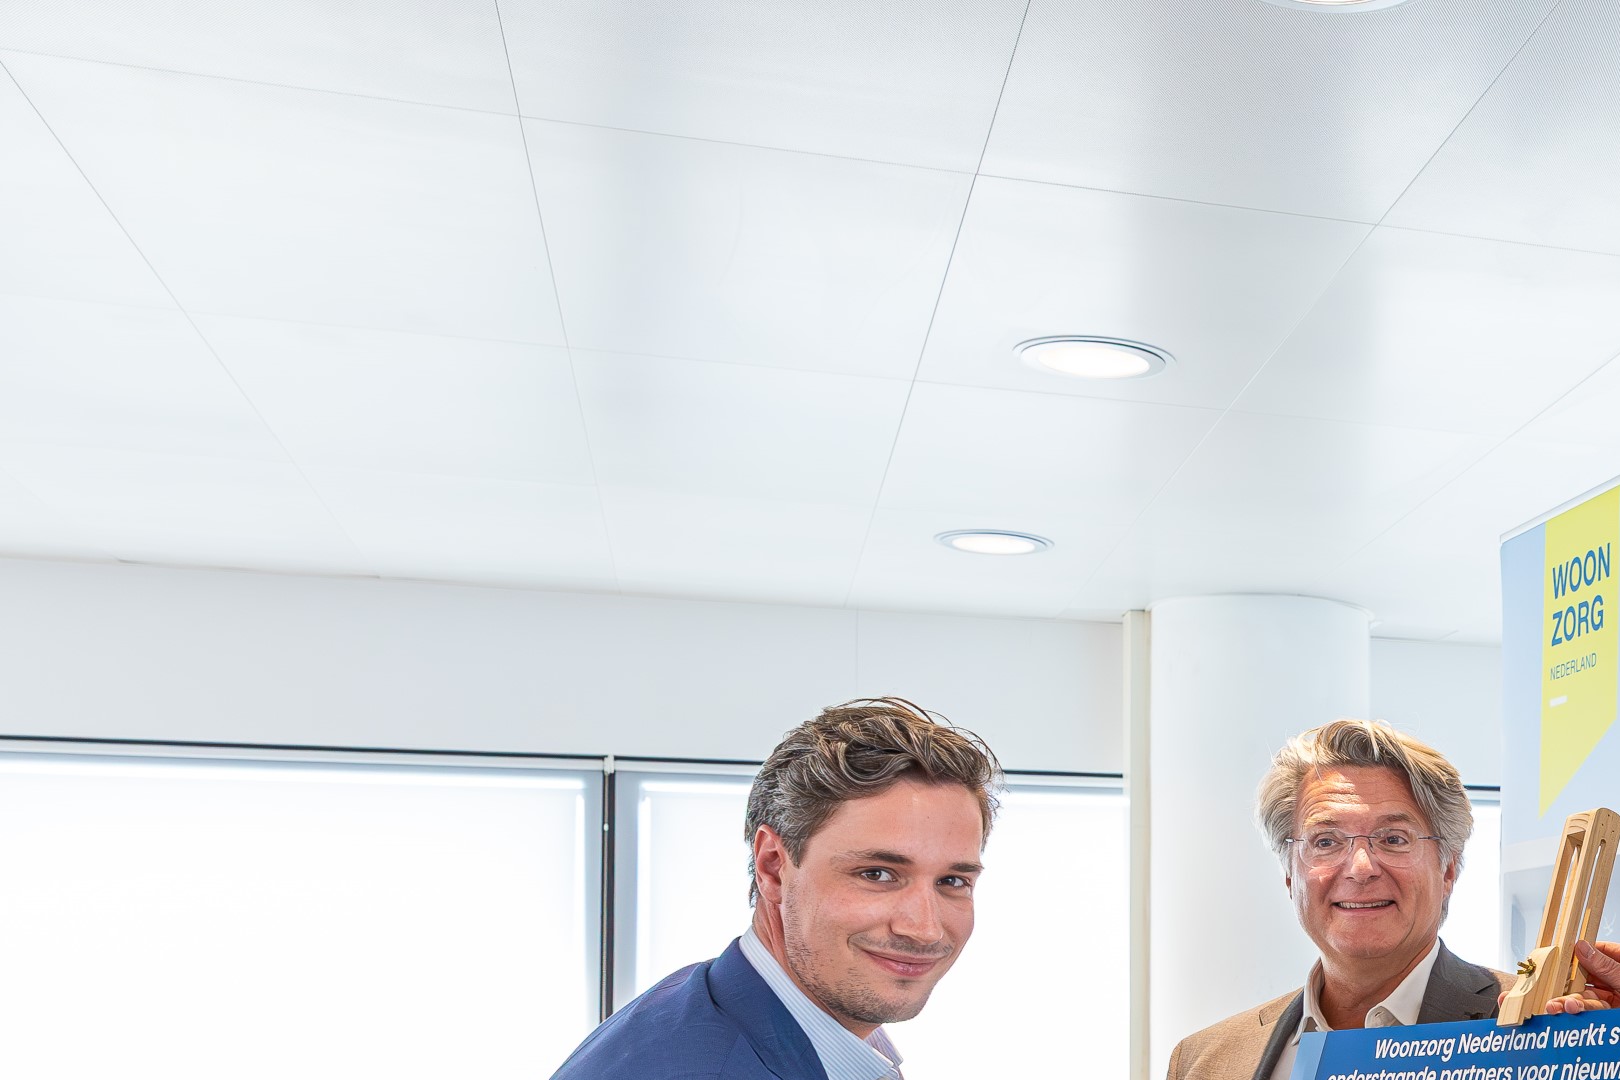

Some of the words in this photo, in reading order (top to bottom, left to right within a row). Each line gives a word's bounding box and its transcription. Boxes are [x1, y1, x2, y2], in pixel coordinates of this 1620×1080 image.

[1552, 542, 1611, 600] WOON
[1551, 595, 1604, 647] ZORG
[1550, 652, 1597, 681] NEDERLAND
[1374, 1038, 1455, 1062] Woonzorg
[1457, 1026, 1550, 1054] Nederland
[1553, 1023, 1606, 1049] werkt
